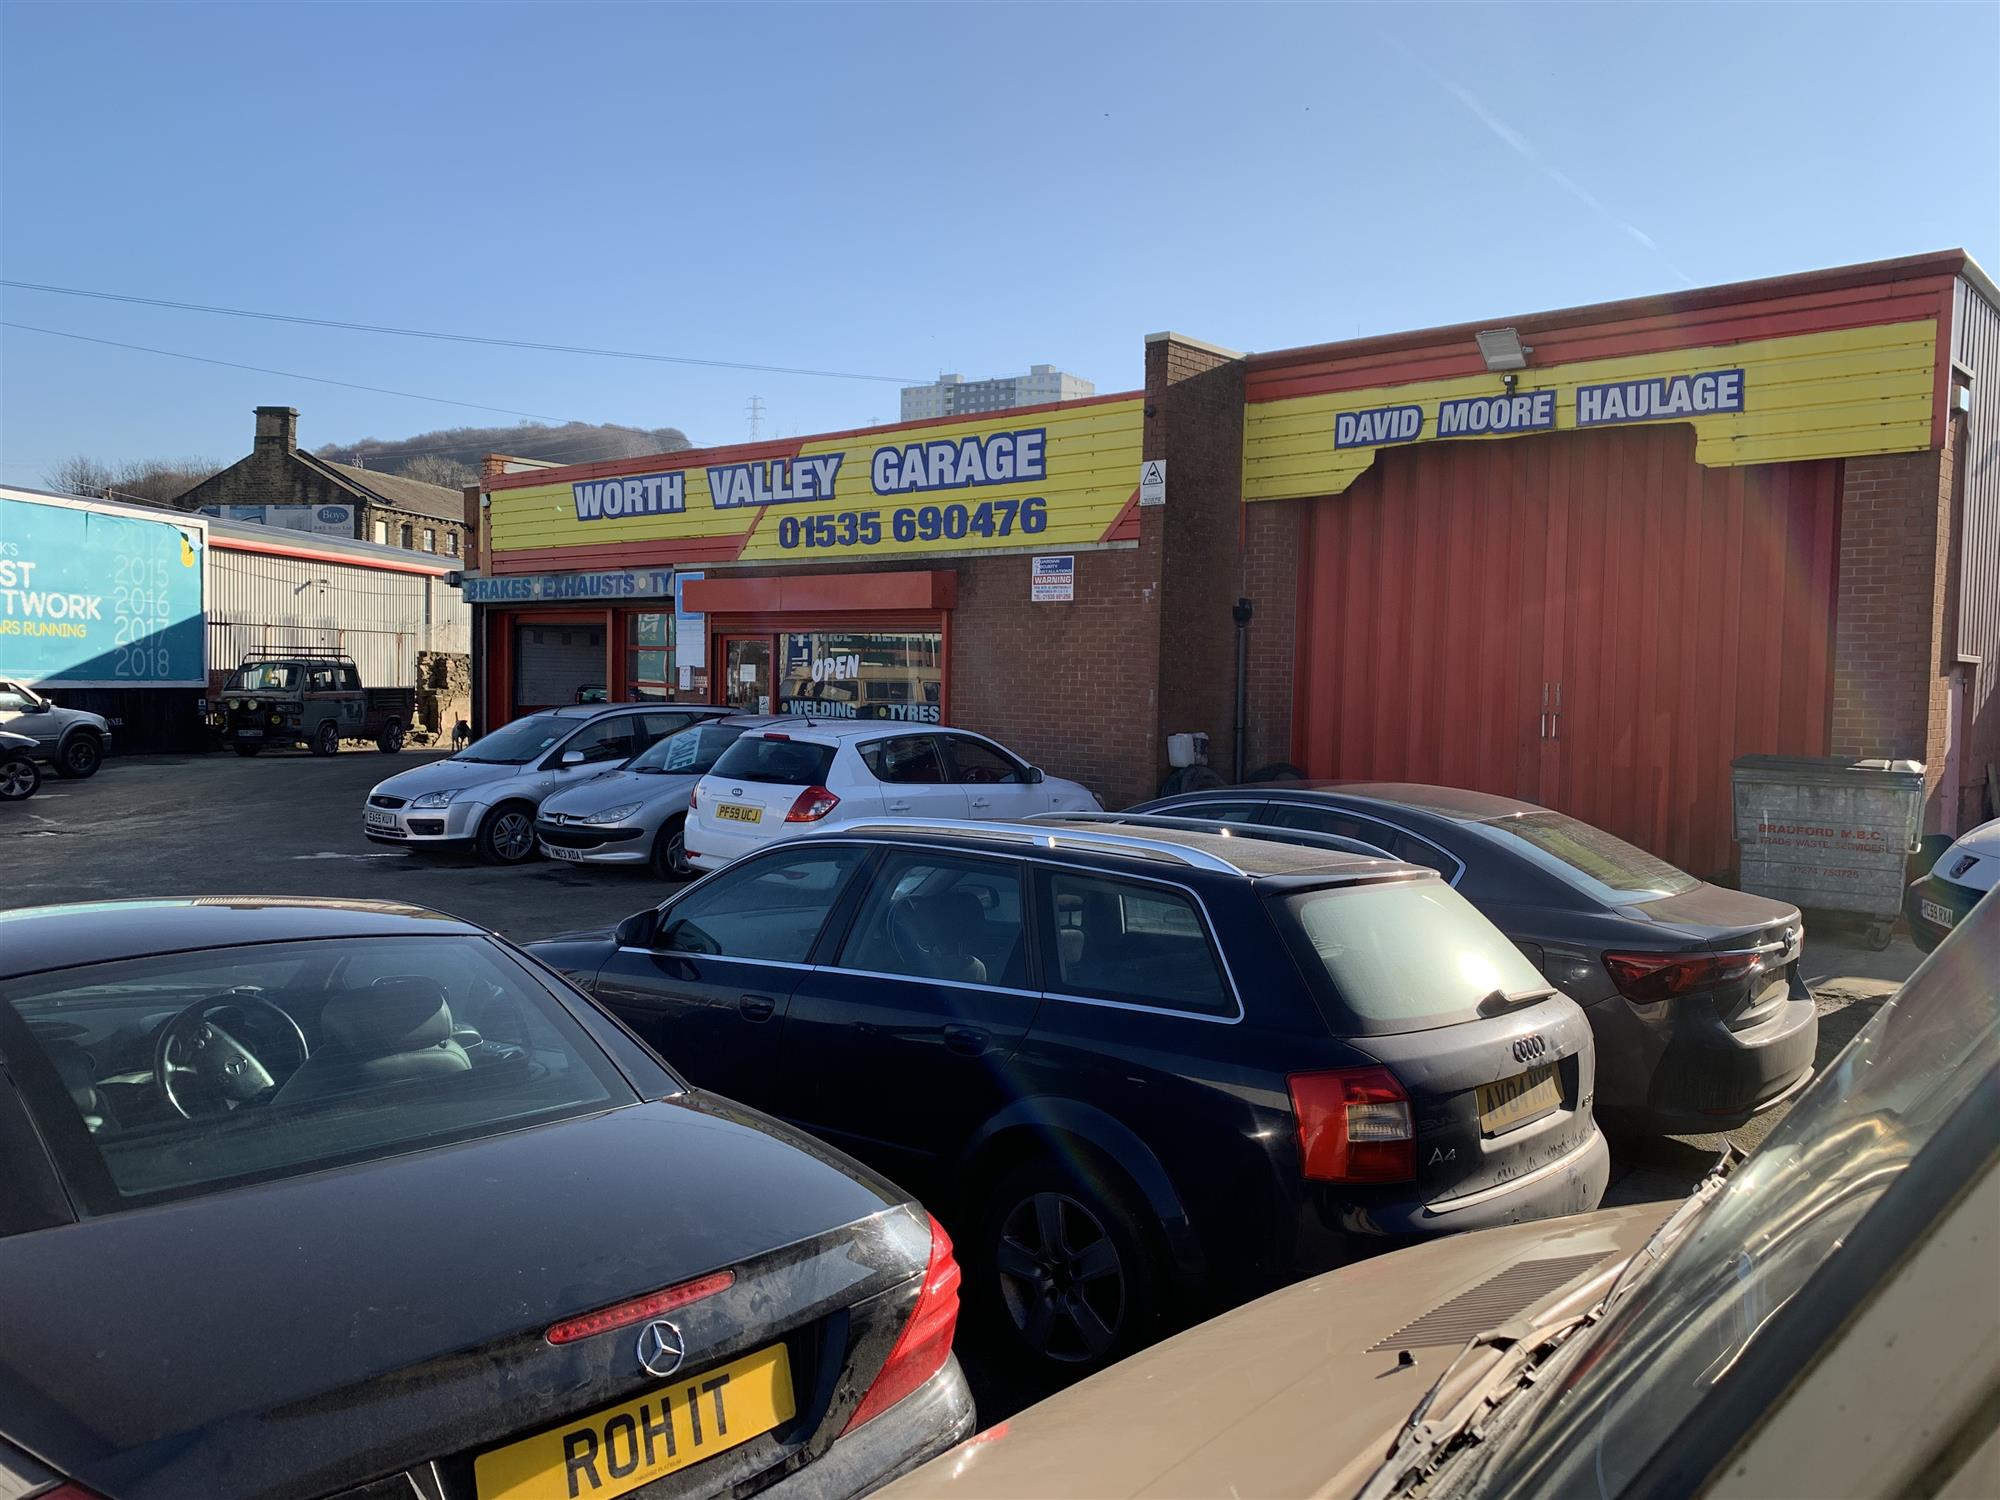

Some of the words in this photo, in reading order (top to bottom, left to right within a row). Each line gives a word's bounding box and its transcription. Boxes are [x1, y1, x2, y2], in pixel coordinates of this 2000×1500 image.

[1337, 407, 1421, 447] DAVID
[1439, 393, 1554, 435] MOORE
[1579, 372, 1741, 423] HAULAGE
[574, 473, 684, 519] WORTH
[708, 455, 842, 506] VALLEY
[872, 430, 1044, 493] GARAGE
[322, 509, 345, 522] Boys
[779, 511, 881, 548] 01535
[893, 497, 1047, 543] 690476
[0, 559, 36, 588] ST
[114, 554, 169, 588] 2015
[1034, 576, 1071, 584] WARNING
[468, 579, 532, 599] BRAKES
[542, 573, 635, 597] EXHAUSTS
[0, 589, 101, 620] TWORK
[114, 587, 170, 616] 2016
[24, 621, 87, 638] RUNNING
[114, 616, 169, 646] 2017
[115, 648, 169, 677] 2018
[812, 654, 859, 683] OPEN
[790, 701, 857, 718] WELDING
[888, 704, 940, 722] TYRES
[369, 812, 381, 823] EA55
[718, 805, 740, 818] PF59
[741, 808, 758, 821] UCJ
[1758, 823, 1834, 837] BRADFORD
[1841, 829, 1885, 841] M.B.C.
[1760, 837, 1792, 846] TRADE
[1795, 839, 1830, 849] WASTE
[1835, 842, 1886, 853] SERVICES
[1486, 1076, 1529, 1121] AV04
[1428, 1147, 1456, 1166] A4
[563, 1397, 677, 1499] ROH
